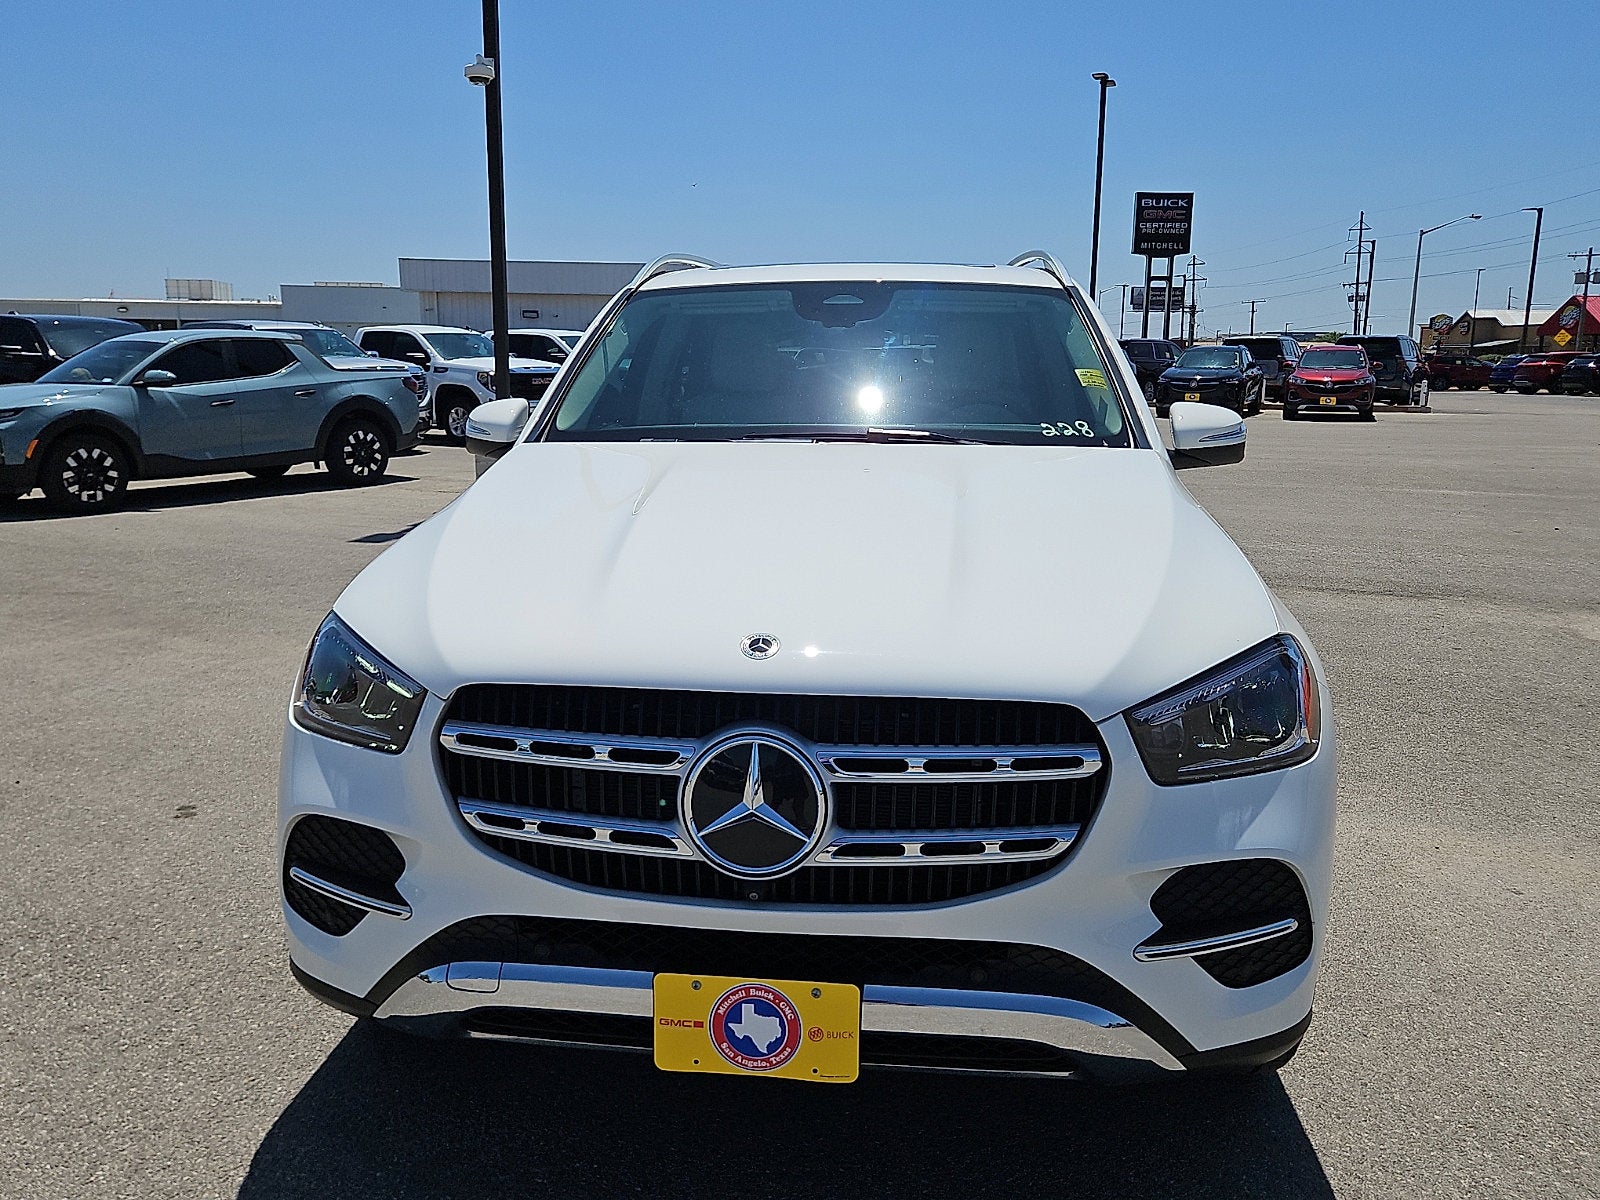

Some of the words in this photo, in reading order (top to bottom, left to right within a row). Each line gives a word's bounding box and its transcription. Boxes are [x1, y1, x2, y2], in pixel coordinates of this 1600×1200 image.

[1141, 199, 1188, 207] BUICK
[1143, 210, 1186, 219] GMC
[1040, 420, 1095, 437] 228
[717, 990, 746, 1015] Mitchell
[749, 988, 775, 1001] Buick
[779, 1001, 795, 1020] GMC
[659, 1017, 693, 1028] GMC
[826, 1031, 854, 1039] BUICK
[720, 1042, 735, 1058] San
[734, 1055, 770, 1067] Angelo,
[769, 1046, 792, 1065] Texas
